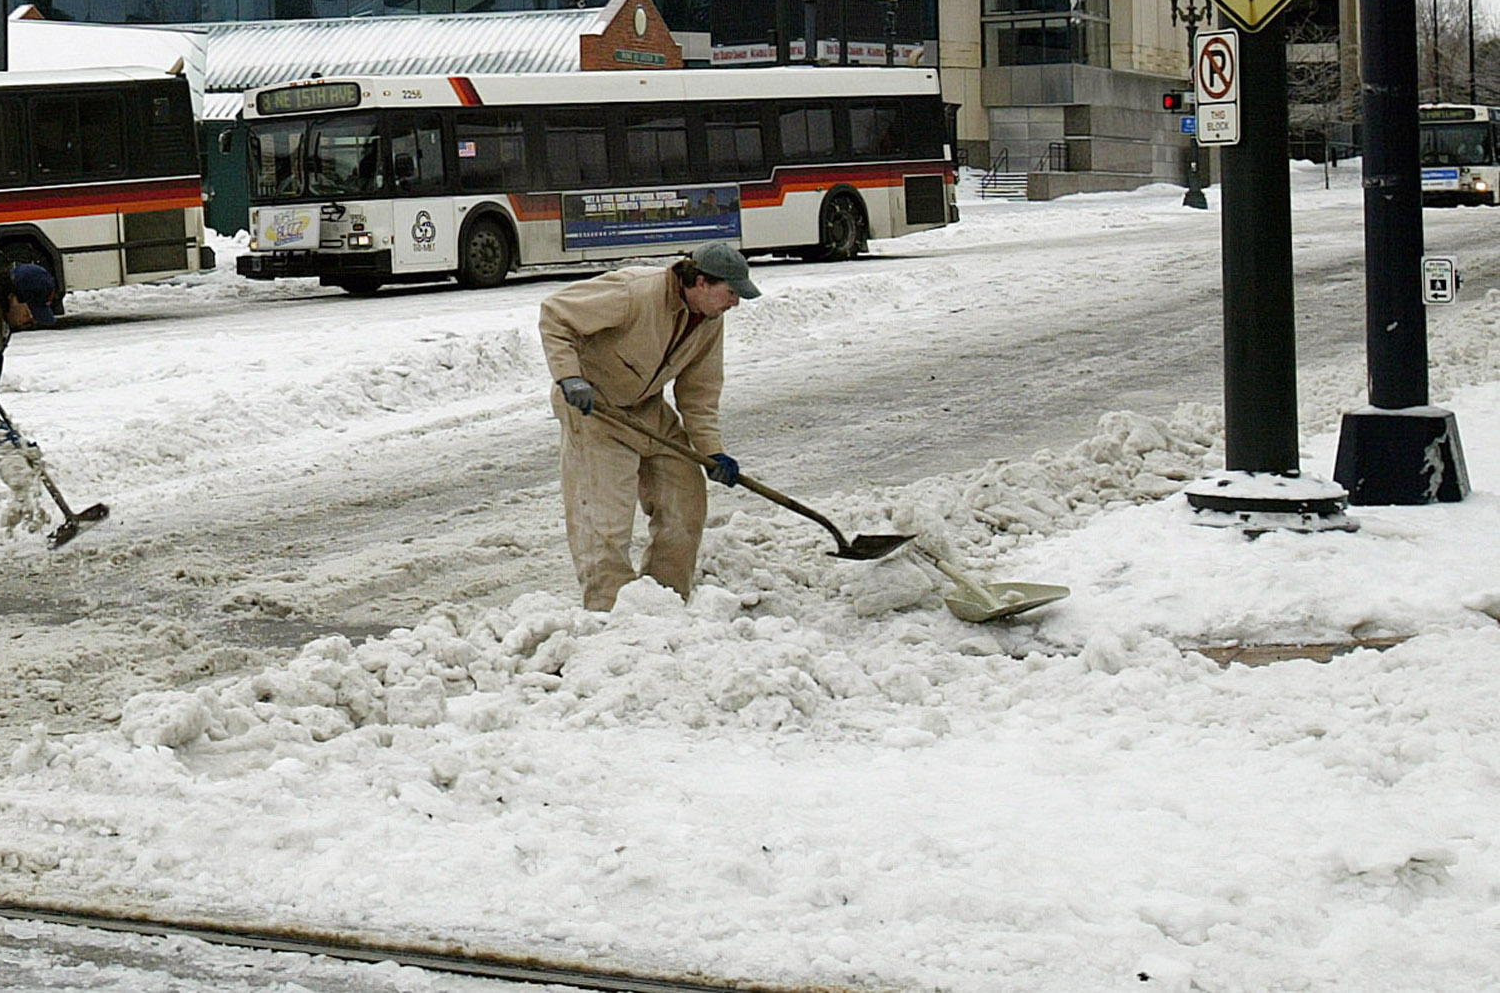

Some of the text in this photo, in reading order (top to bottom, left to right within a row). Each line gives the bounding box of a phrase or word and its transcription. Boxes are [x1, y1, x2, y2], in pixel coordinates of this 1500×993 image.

[275, 91, 291, 109] NE
[295, 89, 327, 108] 15TH
[330, 87, 356, 105] AVE
[1207, 121, 1230, 132] BLOCK
